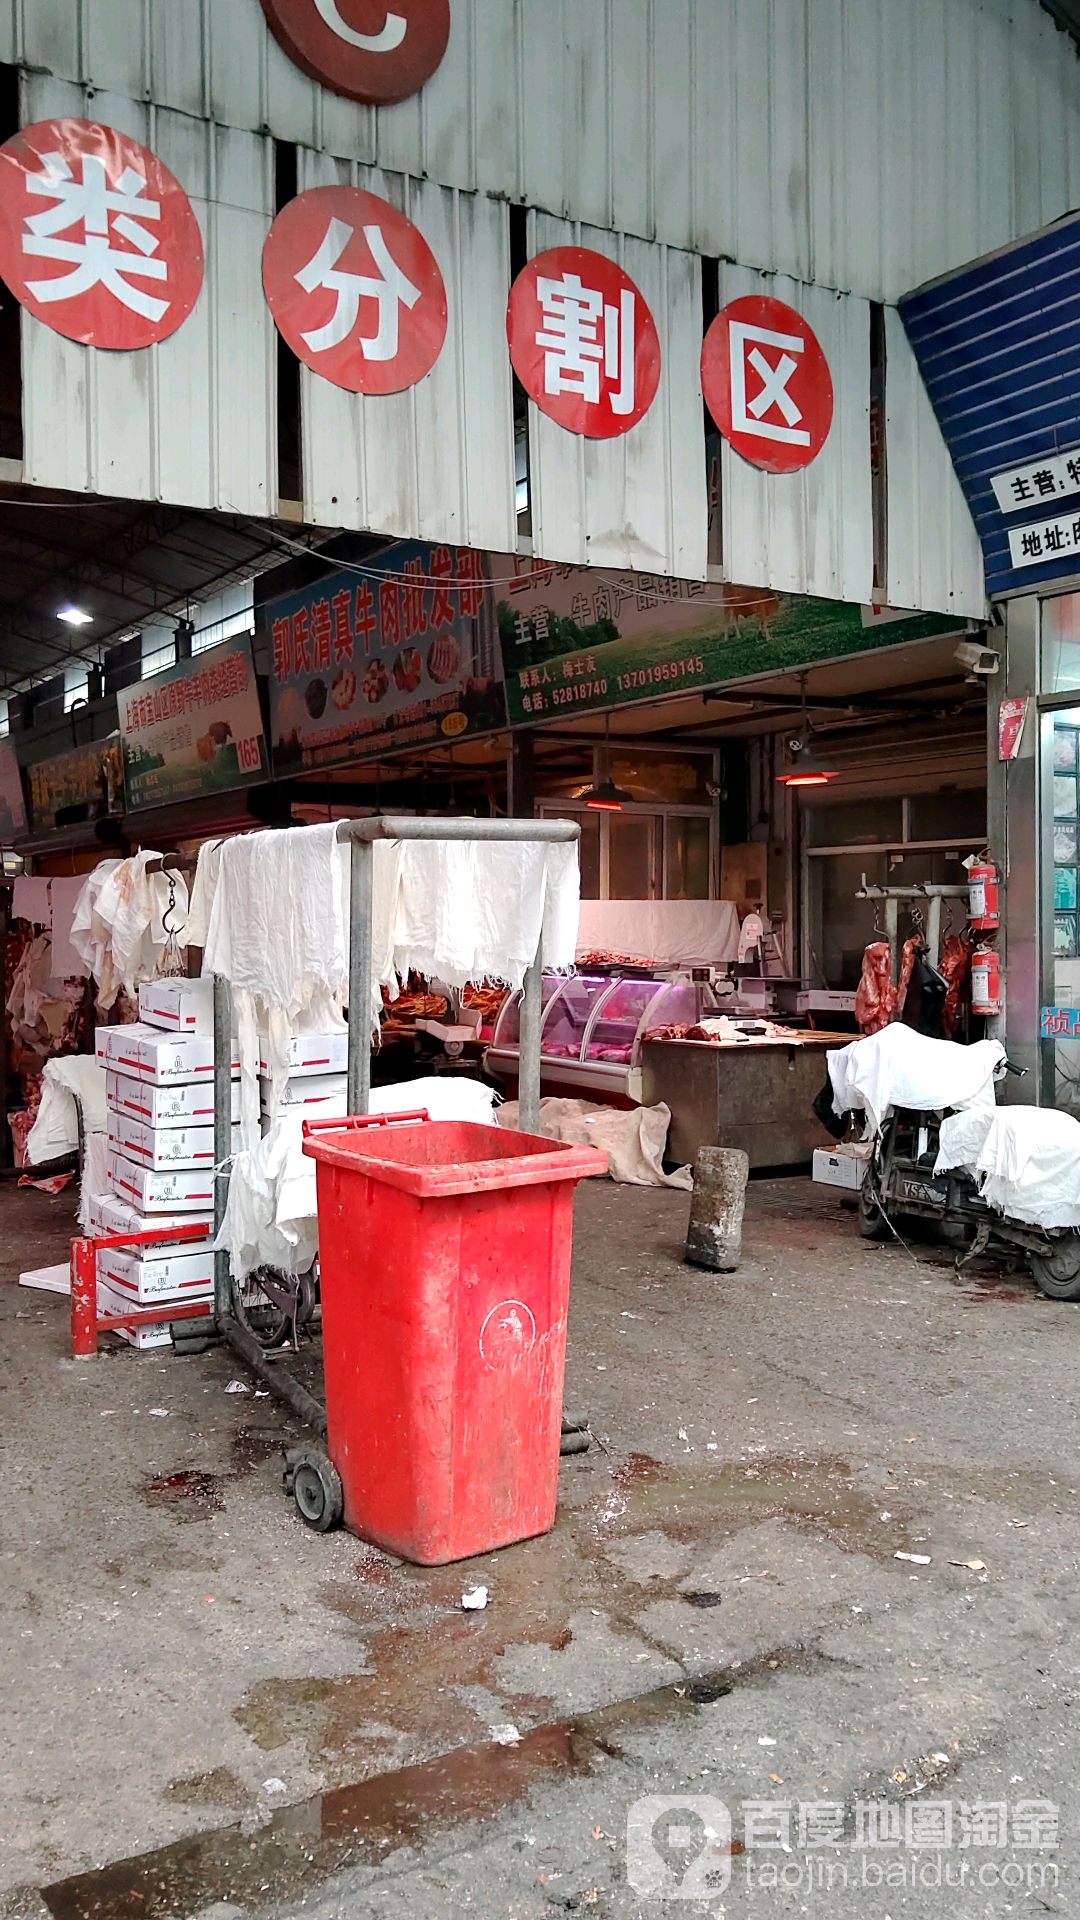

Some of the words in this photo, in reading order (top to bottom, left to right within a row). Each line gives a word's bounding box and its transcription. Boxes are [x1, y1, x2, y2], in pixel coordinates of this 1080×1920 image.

[271, 546, 485, 684] 郭氏清真牛肉批发部
[617, 656, 704, 691] 13701959145
[237, 738, 260, 769] 165
